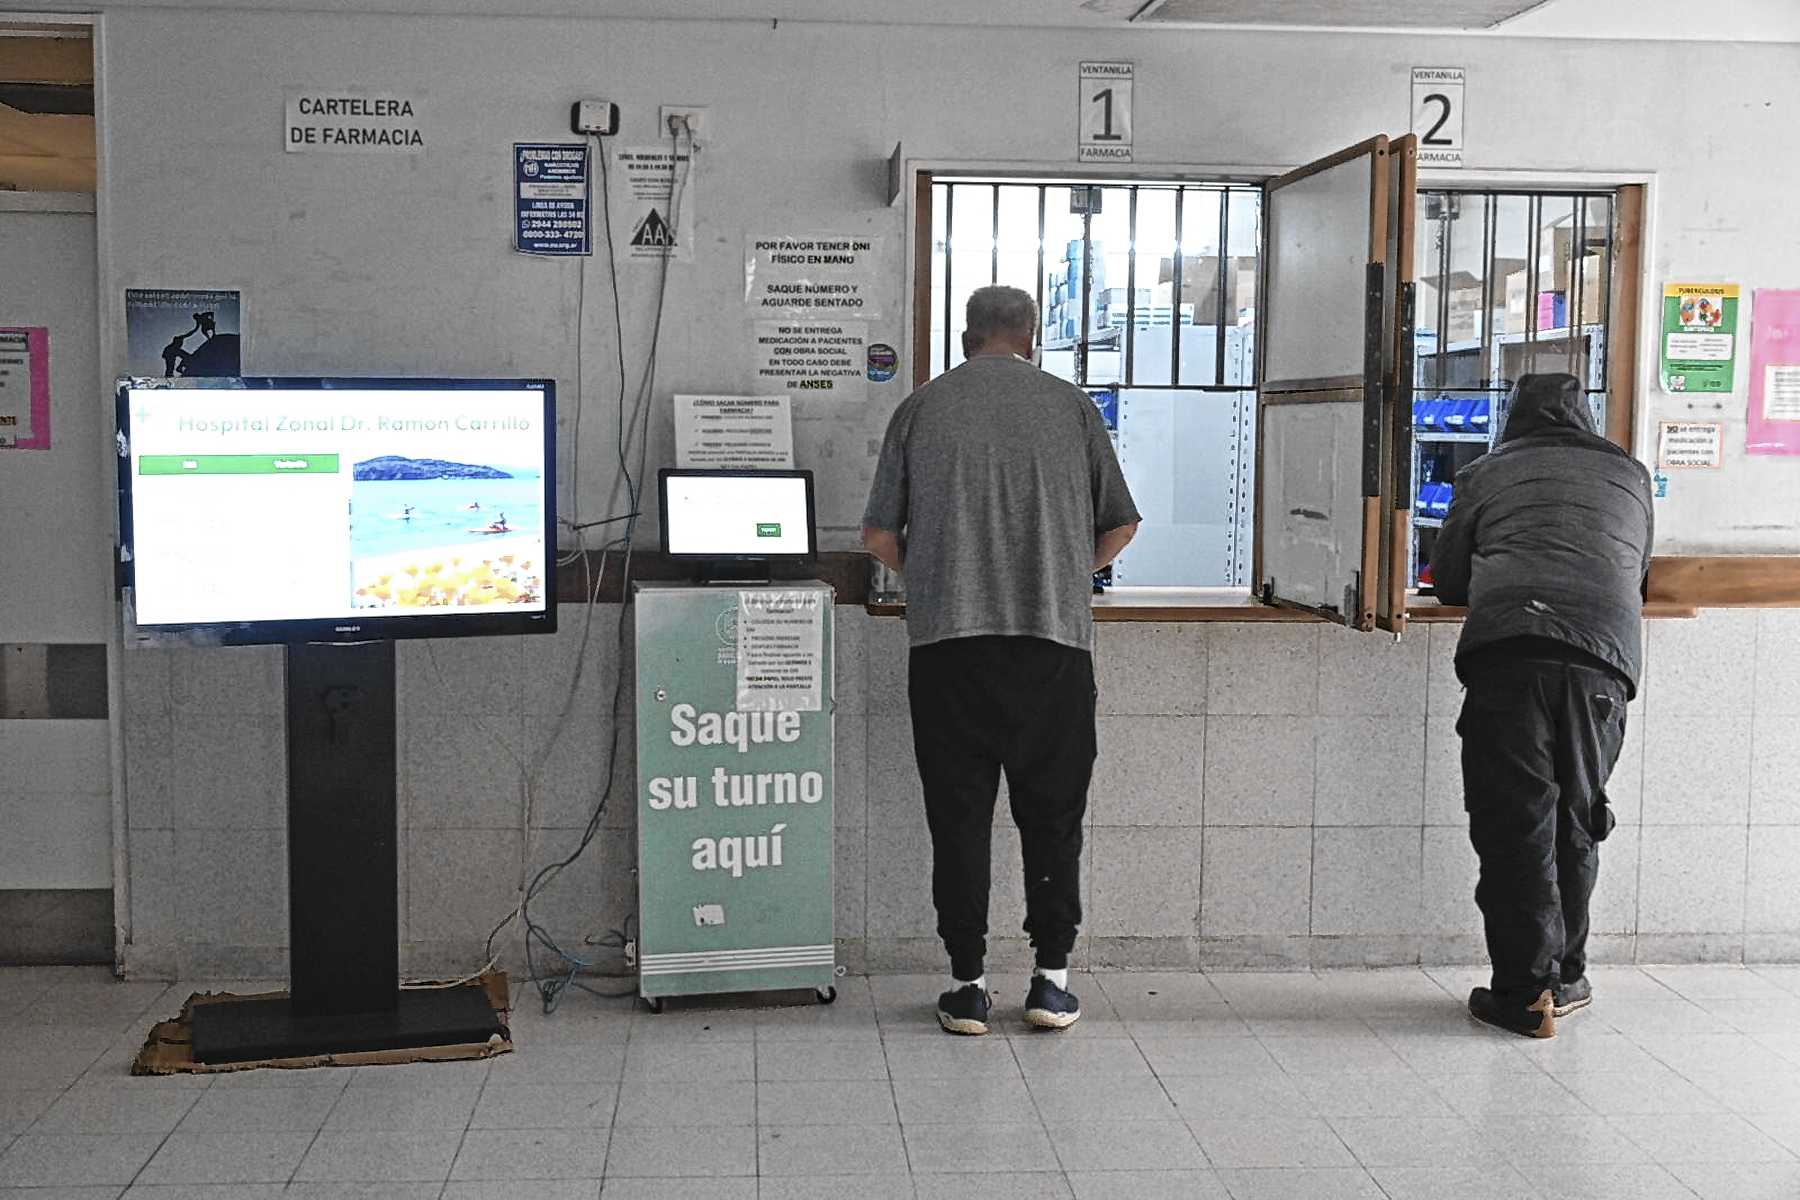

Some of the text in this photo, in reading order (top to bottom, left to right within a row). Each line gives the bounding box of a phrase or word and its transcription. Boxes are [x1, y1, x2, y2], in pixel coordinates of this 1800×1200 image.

[1082, 65, 1131, 74] VENTANILLA
[1414, 71, 1463, 80] VENTANILLA
[299, 98, 414, 116] CARTELERA
[1093, 88, 1122, 140] 1
[1422, 93, 1452, 144] 2
[291, 126, 423, 146] DE FARMACIA
[1081, 147, 1131, 158] FARMACIA
[1416, 152, 1461, 161] ARMACIA
[755, 241, 871, 251] POR FAVOR TENER DNI
[807, 255, 822, 264] EN
[823, 255, 855, 264] MANO
[767, 284, 802, 294] SAQUE
[851, 285, 858, 293] Y
[761, 298, 864, 307] AGUARDE SENTADO
[760, 369, 807, 377] PRESENTAR
[820, 369, 861, 377] NEGATIVA
[799, 380, 834, 390] ANSES
[178, 415, 269, 436] Hospital
[275, 416, 334, 432] Zonal
[341, 415, 371, 431] Dr.
[454, 414, 530, 431] Carrillo
[1666, 425, 1679, 434] NO
[1689, 426, 1715, 434] entrega
[670, 703, 801, 752] Saque
[648, 767, 823, 810] su turno
[692, 823, 787, 878] aquí
